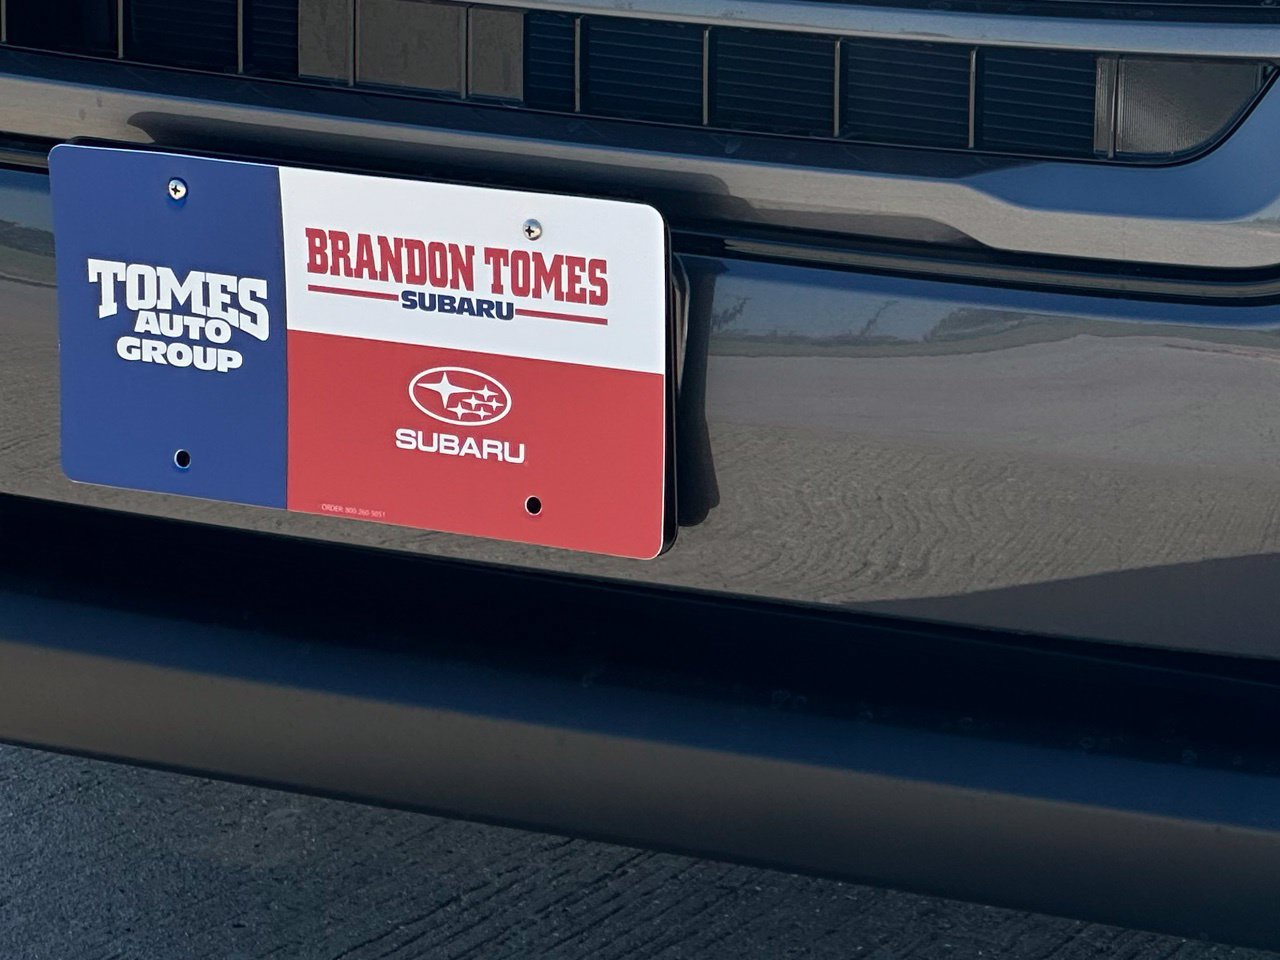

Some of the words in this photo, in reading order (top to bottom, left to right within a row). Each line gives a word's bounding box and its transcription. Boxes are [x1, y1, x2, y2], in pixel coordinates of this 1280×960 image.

[306, 227, 475, 291] BRANDON
[484, 247, 608, 306] TOMES
[87, 258, 270, 341] TOMES
[401, 290, 514, 321] SUBARU
[134, 310, 232, 344] AUTO
[116, 336, 243, 373] GROUP
[395, 428, 525, 464] SUBARU
